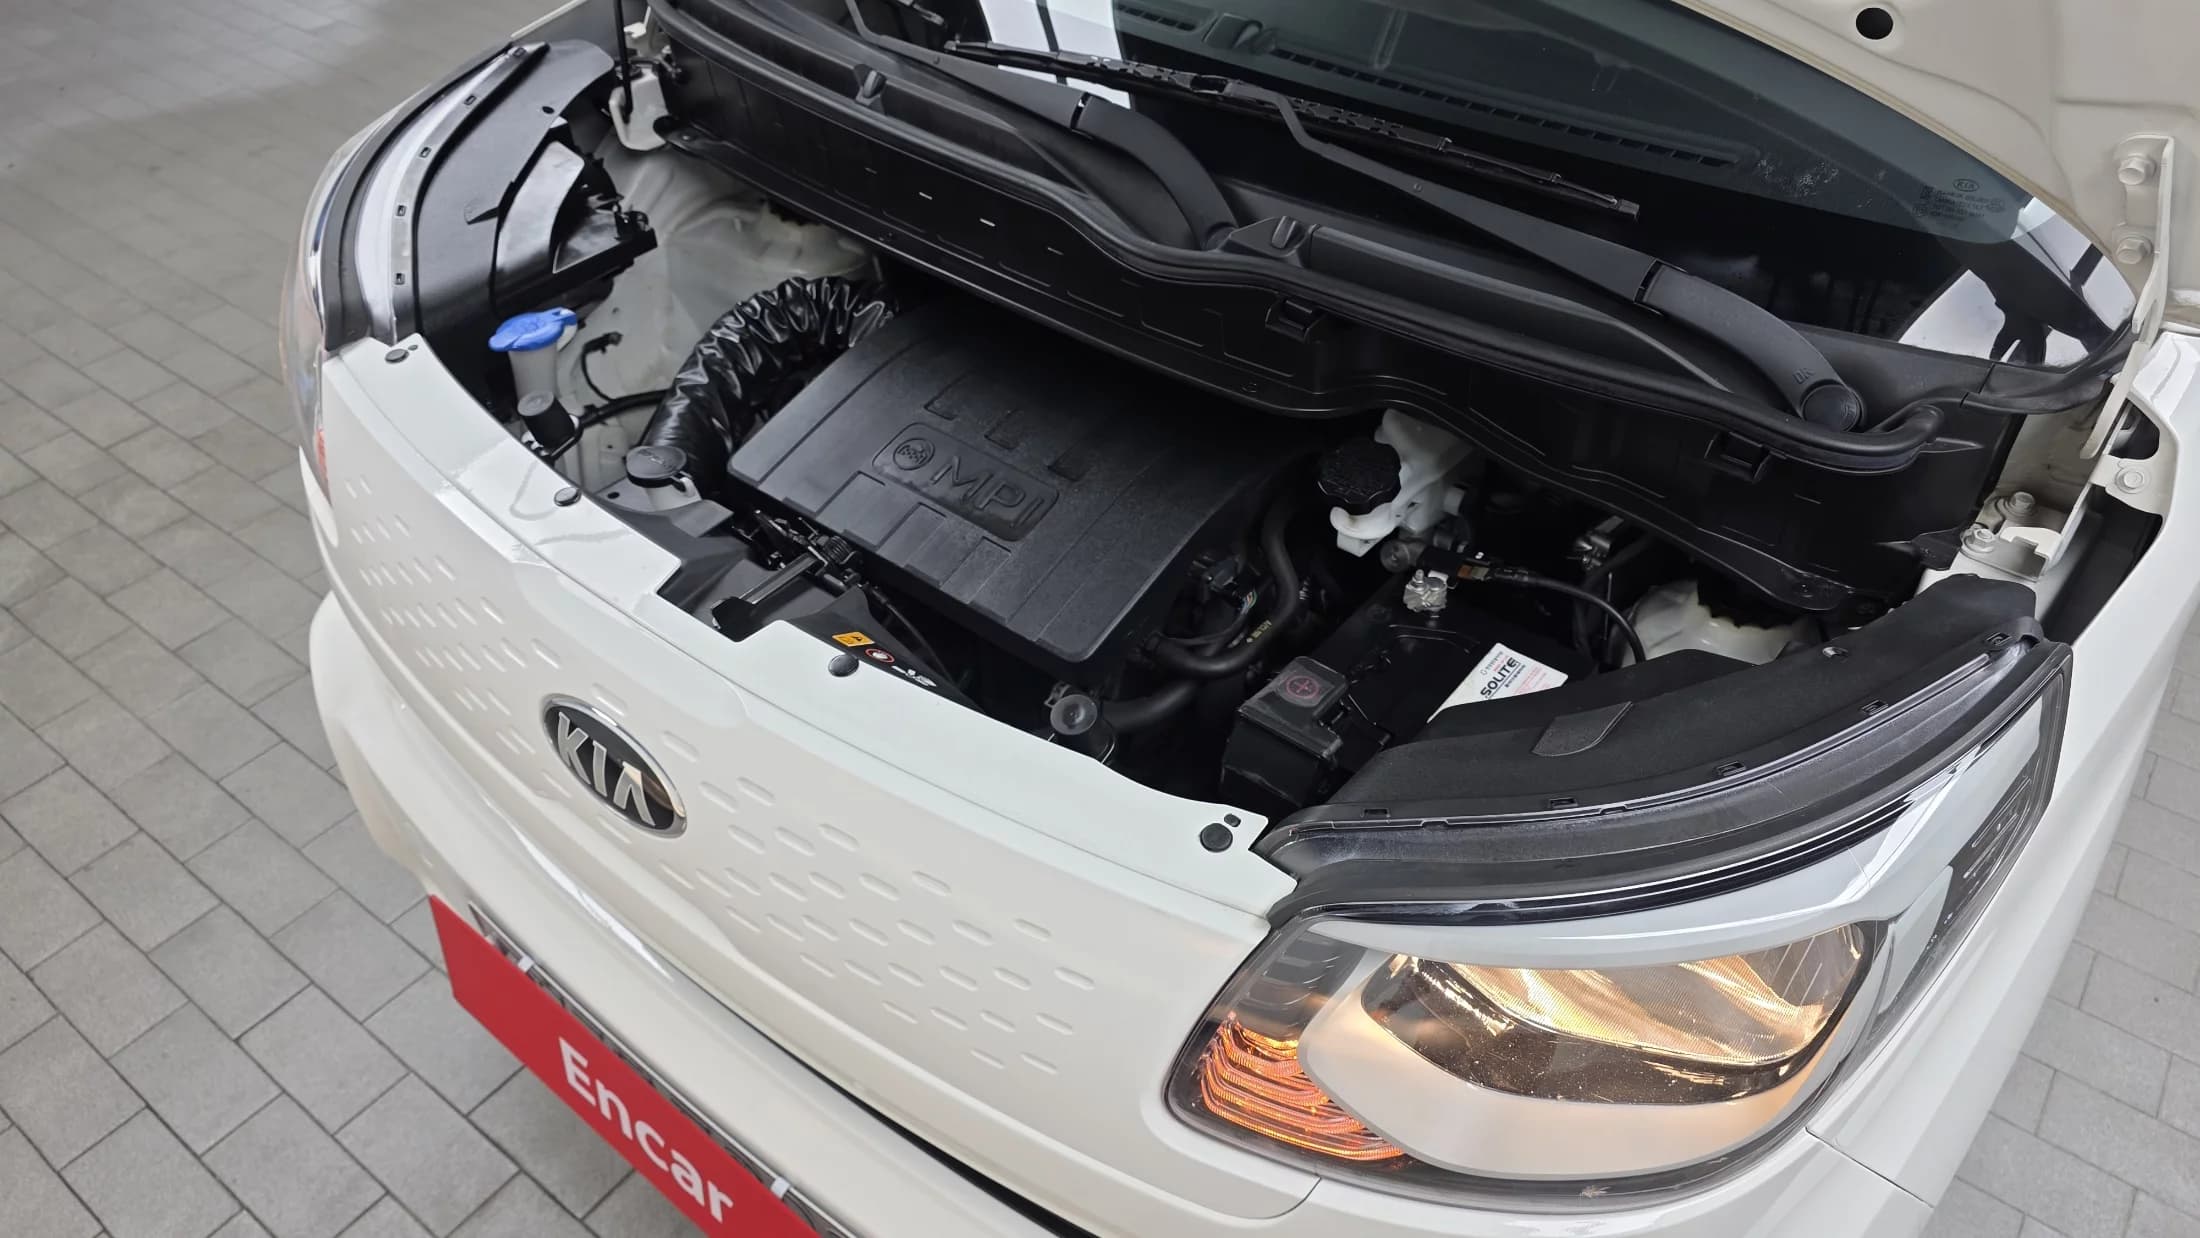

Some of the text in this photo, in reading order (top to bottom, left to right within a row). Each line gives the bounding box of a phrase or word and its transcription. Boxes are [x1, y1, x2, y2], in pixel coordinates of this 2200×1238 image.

[931, 455, 1045, 528] MPI
[1480, 657, 1518, 696] SOLITE
[557, 711, 656, 827] KIA
[558, 1036, 735, 1225] Encar
